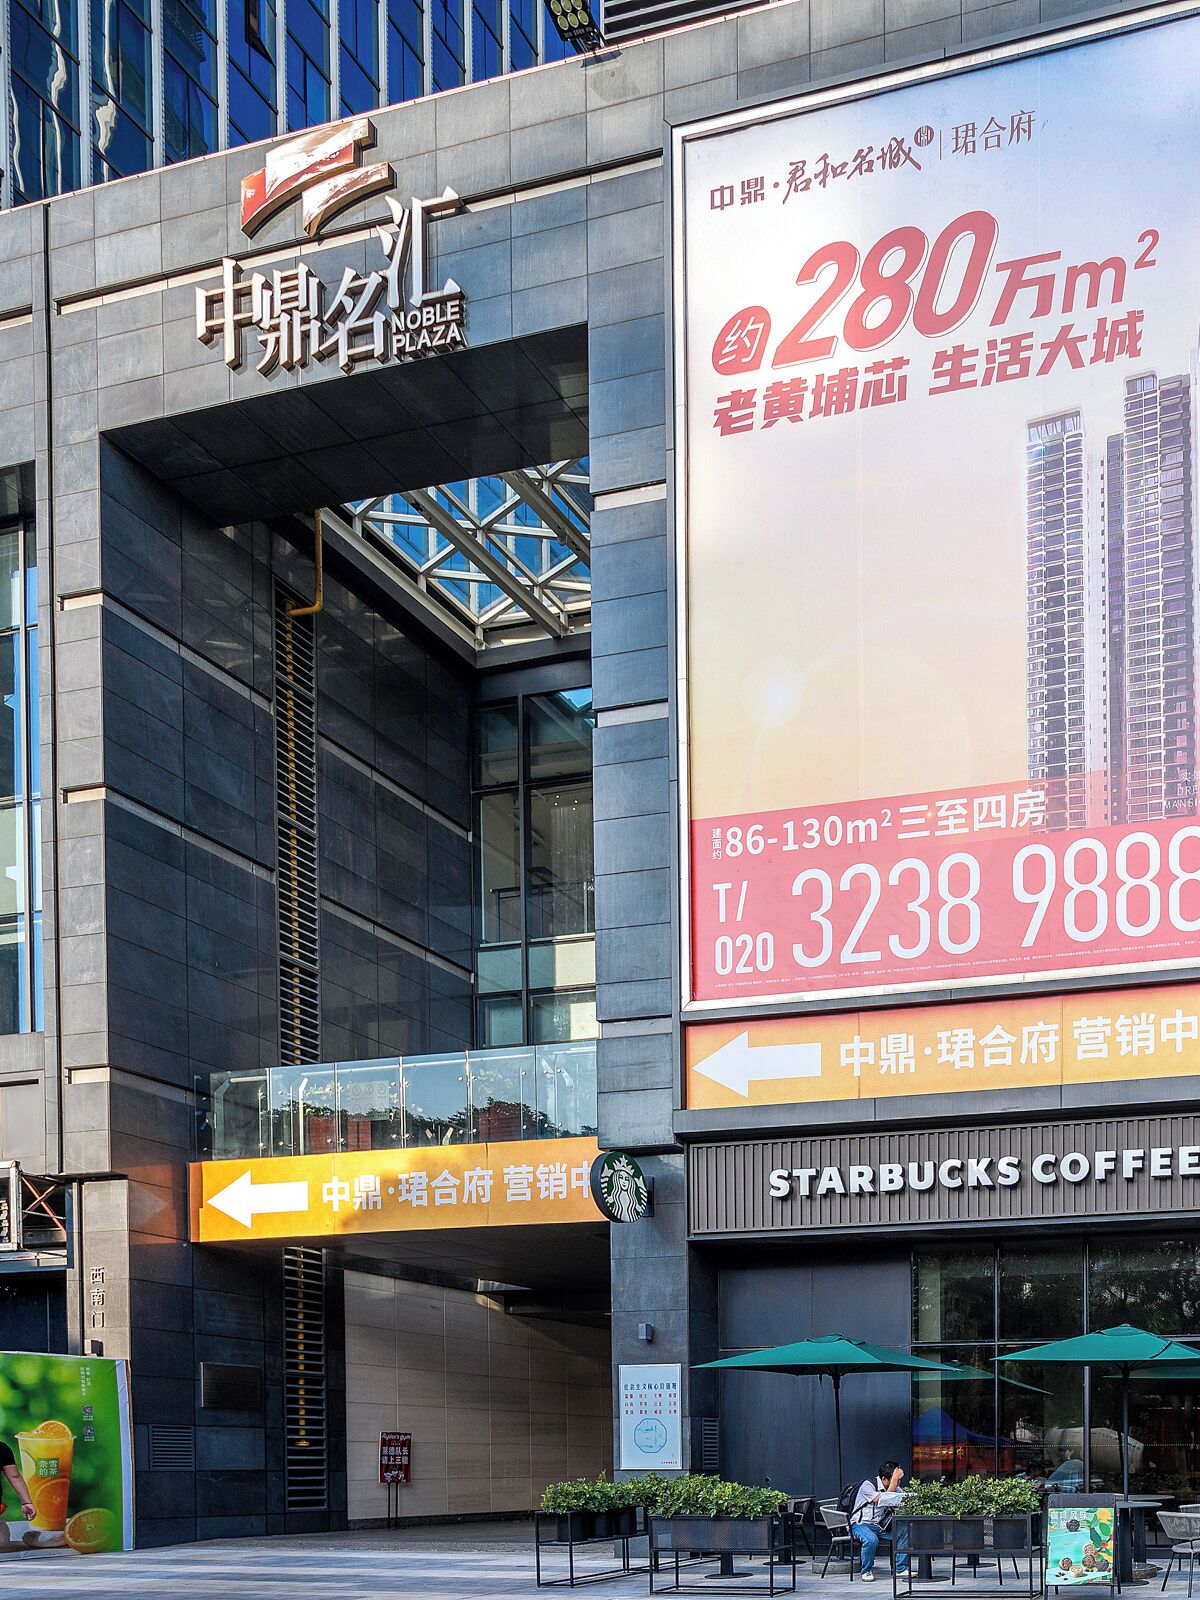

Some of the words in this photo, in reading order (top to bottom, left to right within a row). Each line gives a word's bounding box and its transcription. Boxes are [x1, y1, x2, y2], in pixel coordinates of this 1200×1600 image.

[952, 109, 1037, 157] 珺合府
[195, 186, 467, 376] 中鼎名汇
[392, 300, 461, 334] NOBLE
[392, 322, 462, 355] PLAZA
[712, 356, 911, 437] 老黄埔芯
[928, 309, 1145, 396] 生活大城
[712, 828, 722, 860] 建面约
[713, 880, 748, 923] T/
[792, 852, 981, 969] 3238
[715, 931, 774, 976] 020
[839, 1022, 1060, 1077] 中鼎·珺合府
[322, 1166, 494, 1212] 中鼎·珺合府
[768, 1156, 1022, 1199] STARBUCKS
[90, 1267, 106, 1328] 西南门
